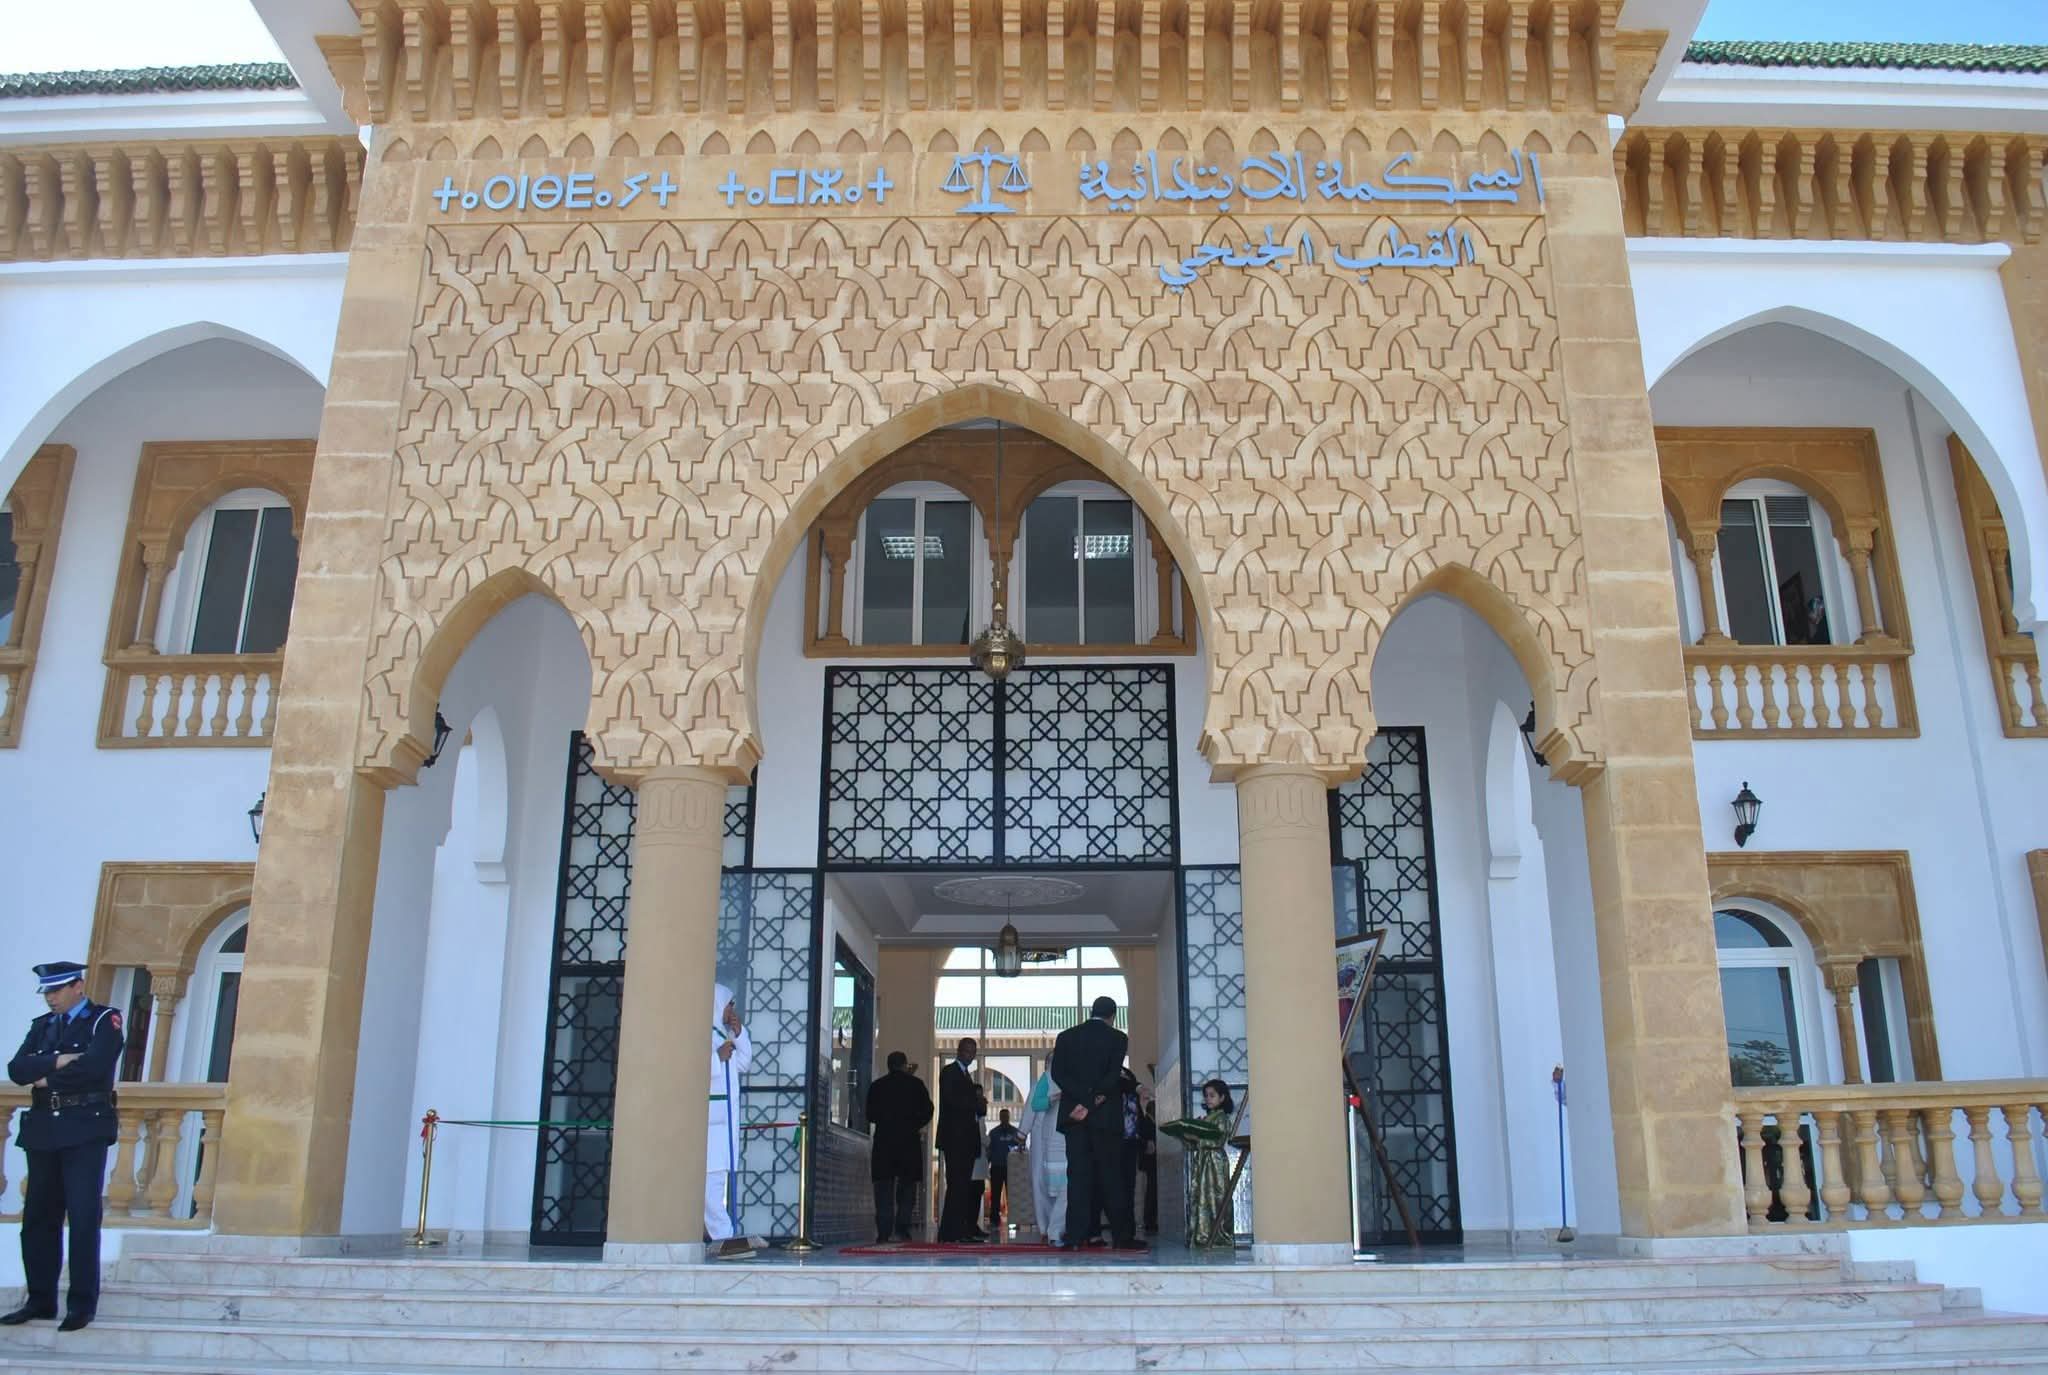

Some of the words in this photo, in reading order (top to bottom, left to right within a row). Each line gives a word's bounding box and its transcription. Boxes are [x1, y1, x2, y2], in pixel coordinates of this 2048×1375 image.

[1079, 149, 1309, 212] الابتدائية
[1315, 148, 1546, 205] المحكمة
[1158, 224, 1314, 295] الجنحي
[1333, 225, 1476, 285] القطب
